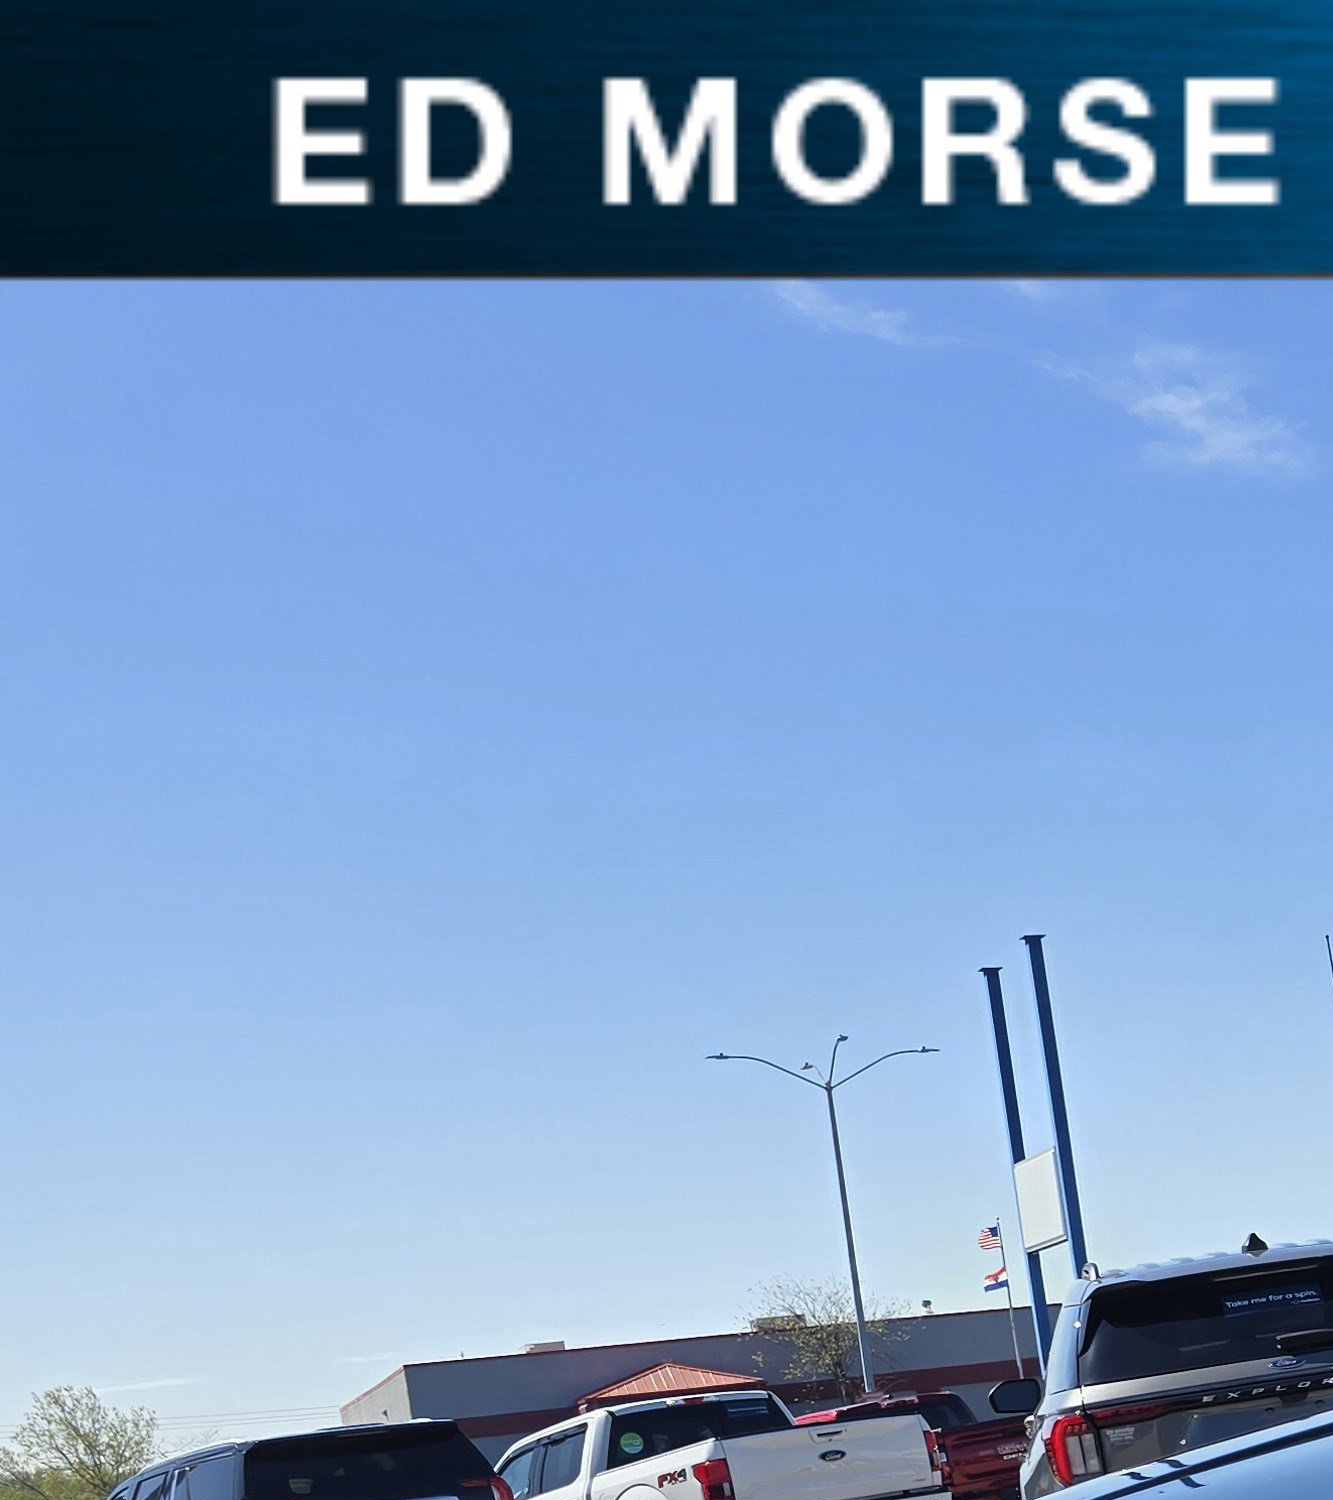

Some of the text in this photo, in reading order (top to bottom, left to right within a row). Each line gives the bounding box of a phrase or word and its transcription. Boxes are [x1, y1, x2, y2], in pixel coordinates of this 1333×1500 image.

[1224, 1300, 1249, 1309] Take
[1250, 1297, 1267, 1305] me
[1268, 1294, 1284, 1302] for
[657, 1468, 688, 1489] FX4
